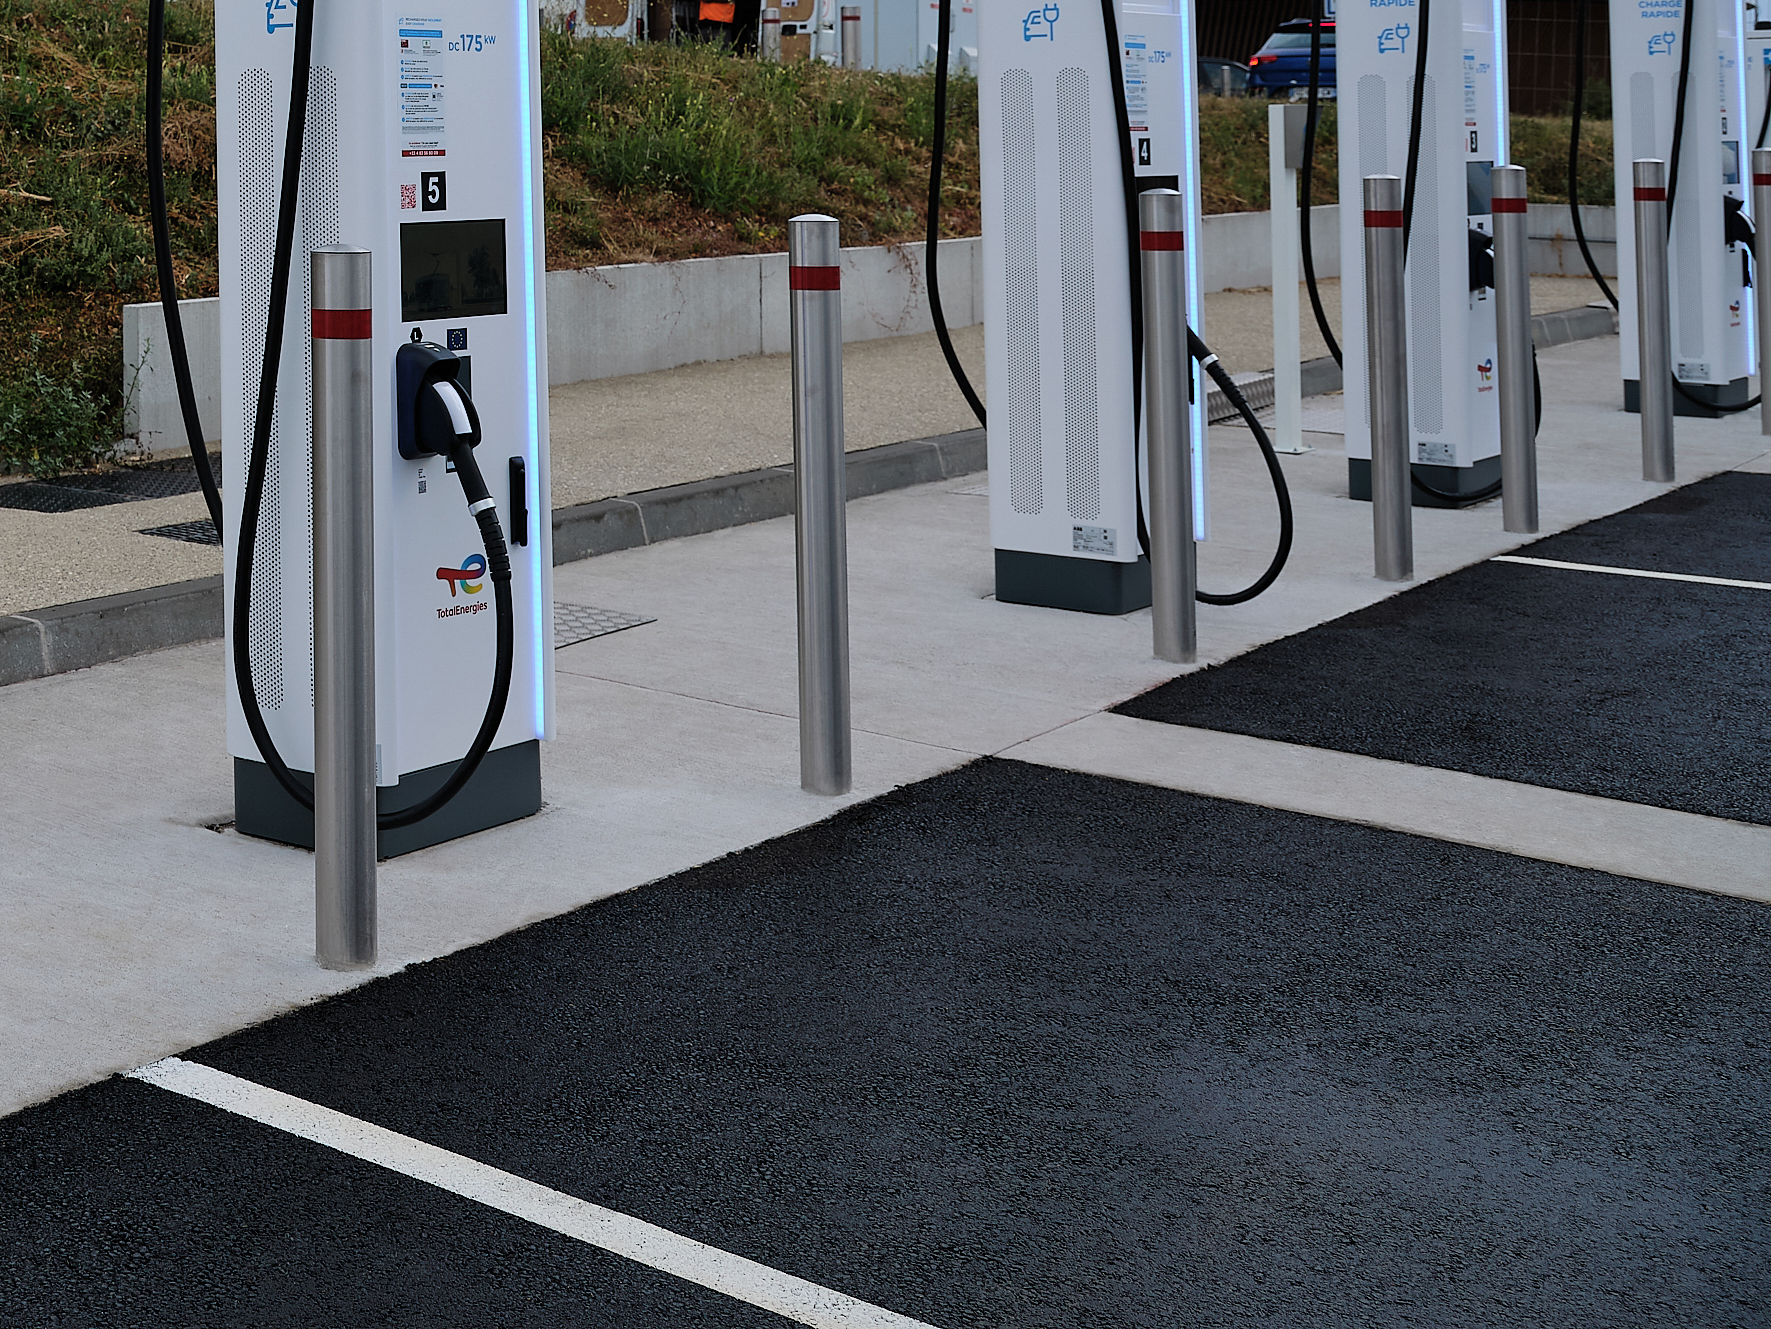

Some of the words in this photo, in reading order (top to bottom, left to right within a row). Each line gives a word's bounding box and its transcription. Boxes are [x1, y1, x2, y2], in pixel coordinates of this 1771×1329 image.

[1638, 0, 1683, 9] CHARGE
[1641, 9, 1681, 19] RAPIDE
[448, 42, 460, 52] DC
[460, 33, 483, 53] 175
[484, 35, 497, 45] kW
[1154, 50, 1165, 63] 175
[1141, 141, 1148, 160] 4
[427, 176, 440, 204] 5
[436, 601, 488, 619] TotalEnergies
